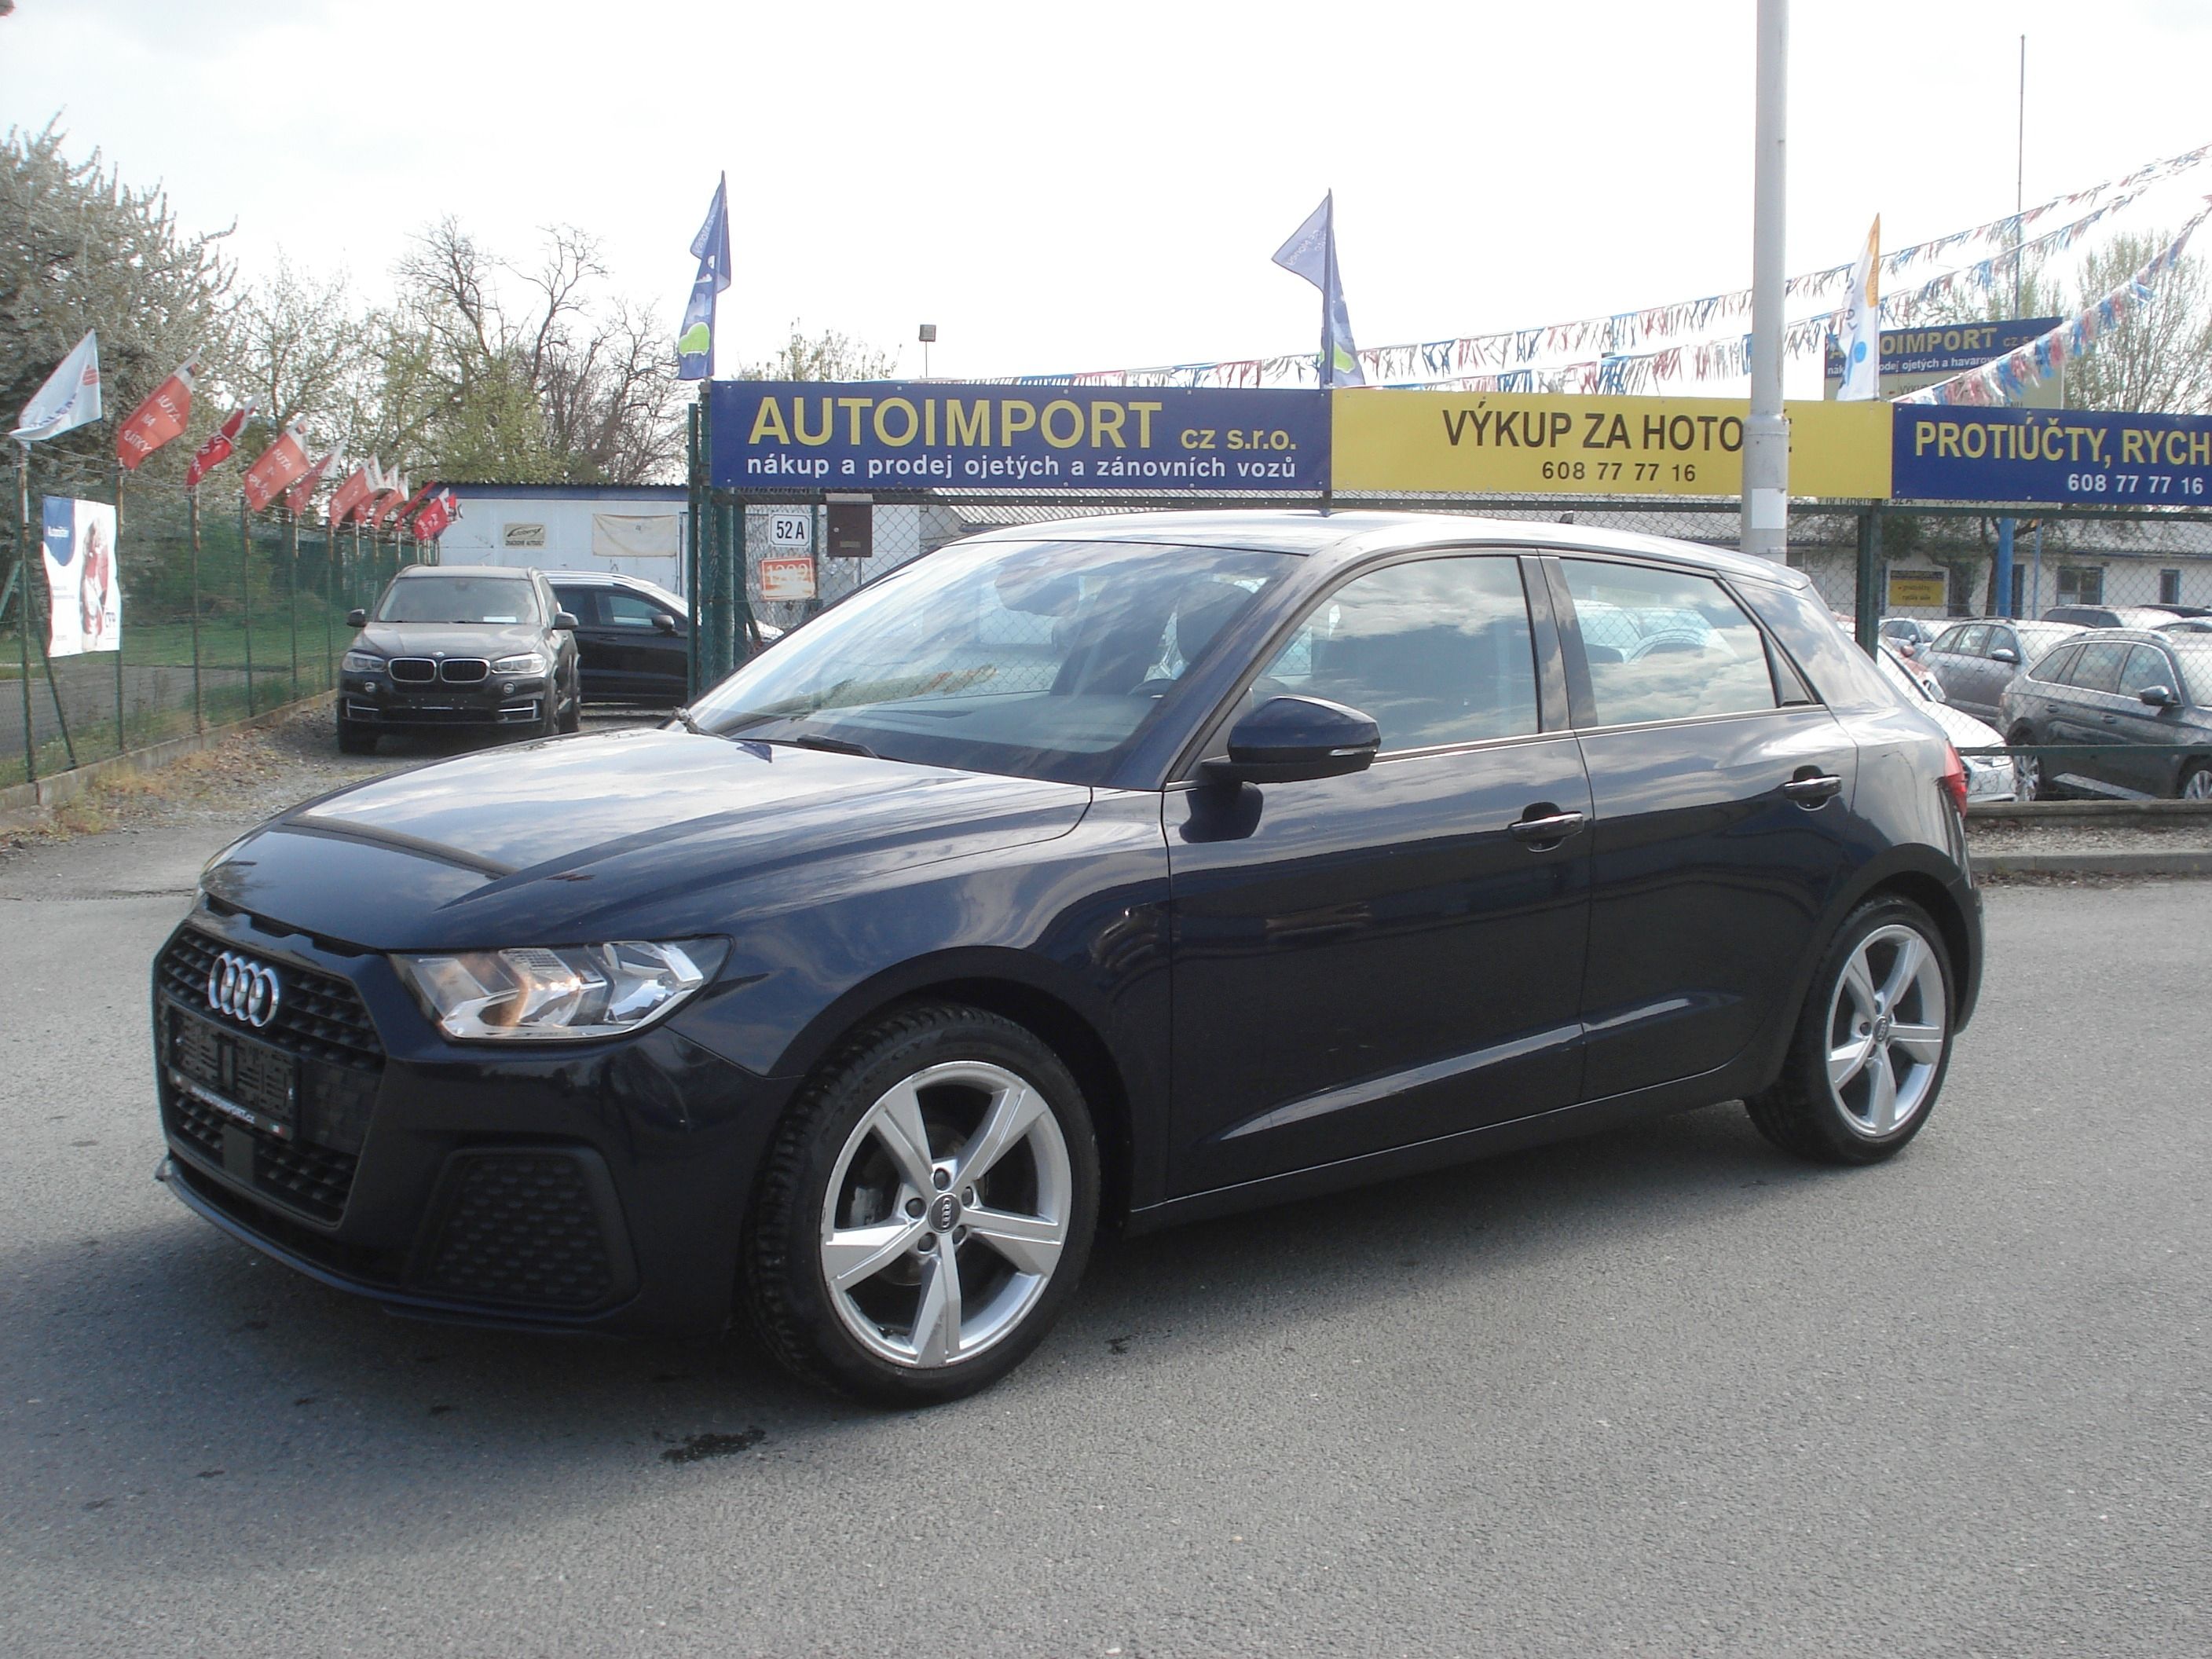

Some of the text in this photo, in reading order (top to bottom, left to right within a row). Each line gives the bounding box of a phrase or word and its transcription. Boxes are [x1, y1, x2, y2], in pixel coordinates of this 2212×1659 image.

[1829, 326, 1998, 359] AOIMPORT
[1828, 364, 1844, 375] nák
[1902, 357, 1939, 372] ojetých
[749, 397, 1163, 449] AUTOIMPORT
[1227, 430, 1297, 452] s.r.o.
[1442, 401, 1793, 453] VÝKUP ZA HOTO
[1915, 416, 2210, 470] PROTIÚČTY, RYCH
[749, 454, 1296, 481] nákup a prodej ojetých a zánovních vozů
[1542, 462, 1696, 483] 608 77 77 16
[2069, 474, 2203, 495] 608 77 77 16
